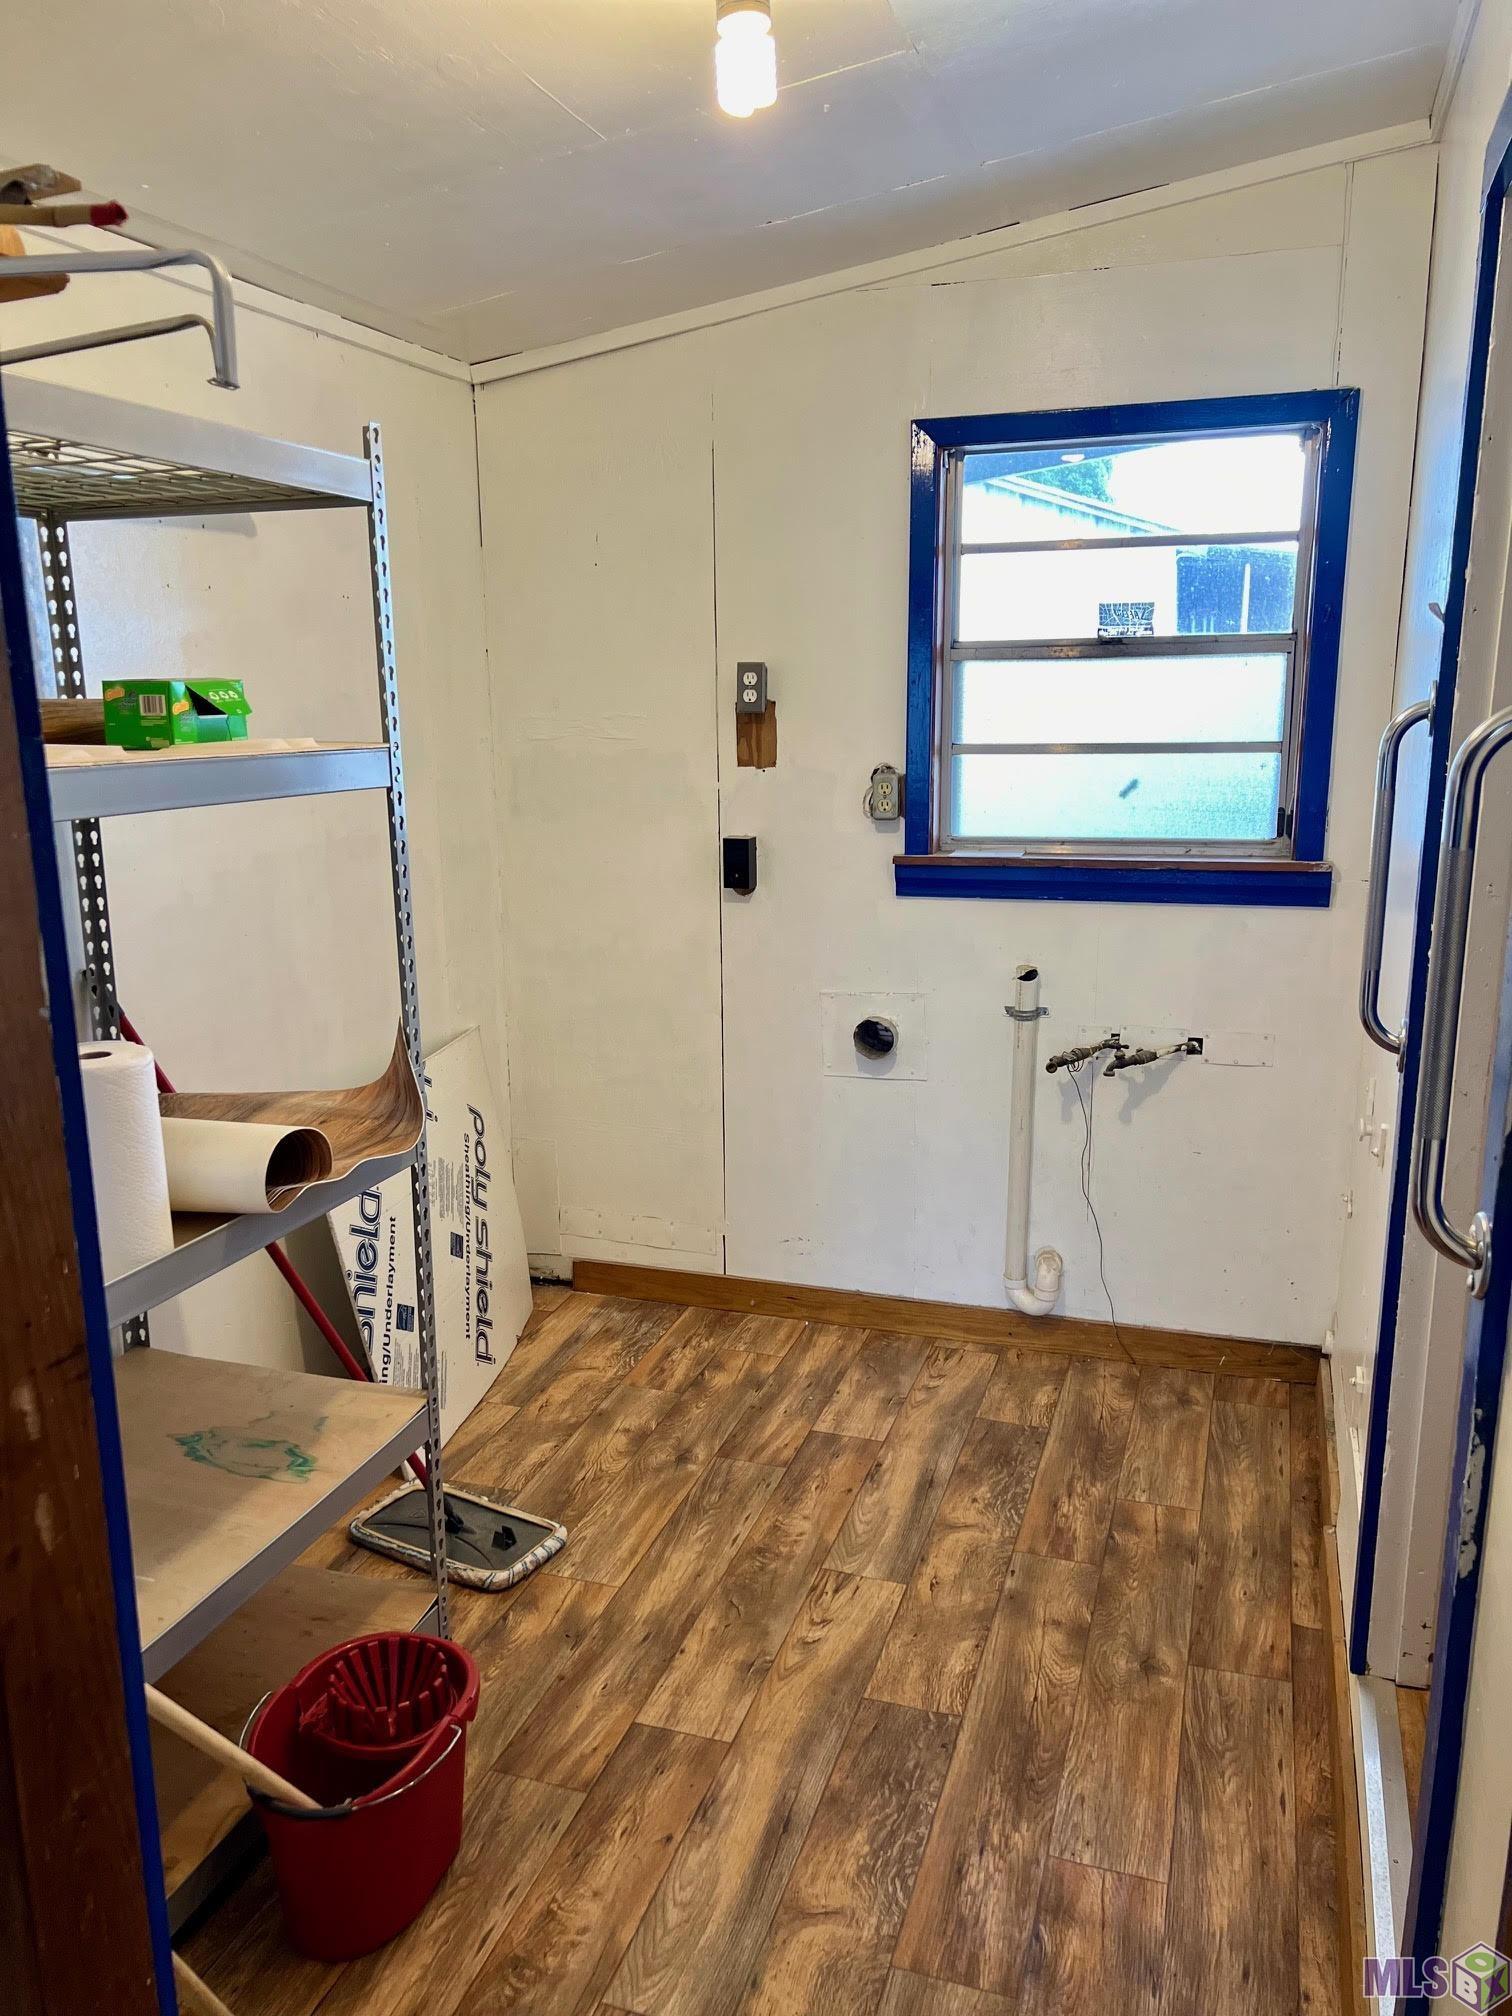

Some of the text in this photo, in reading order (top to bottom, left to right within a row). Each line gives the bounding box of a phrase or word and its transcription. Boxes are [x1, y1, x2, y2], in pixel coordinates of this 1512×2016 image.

[463, 1133, 472, 1340] Sheathing/Underlayment
[467, 1103, 498, 1366] poly shield
